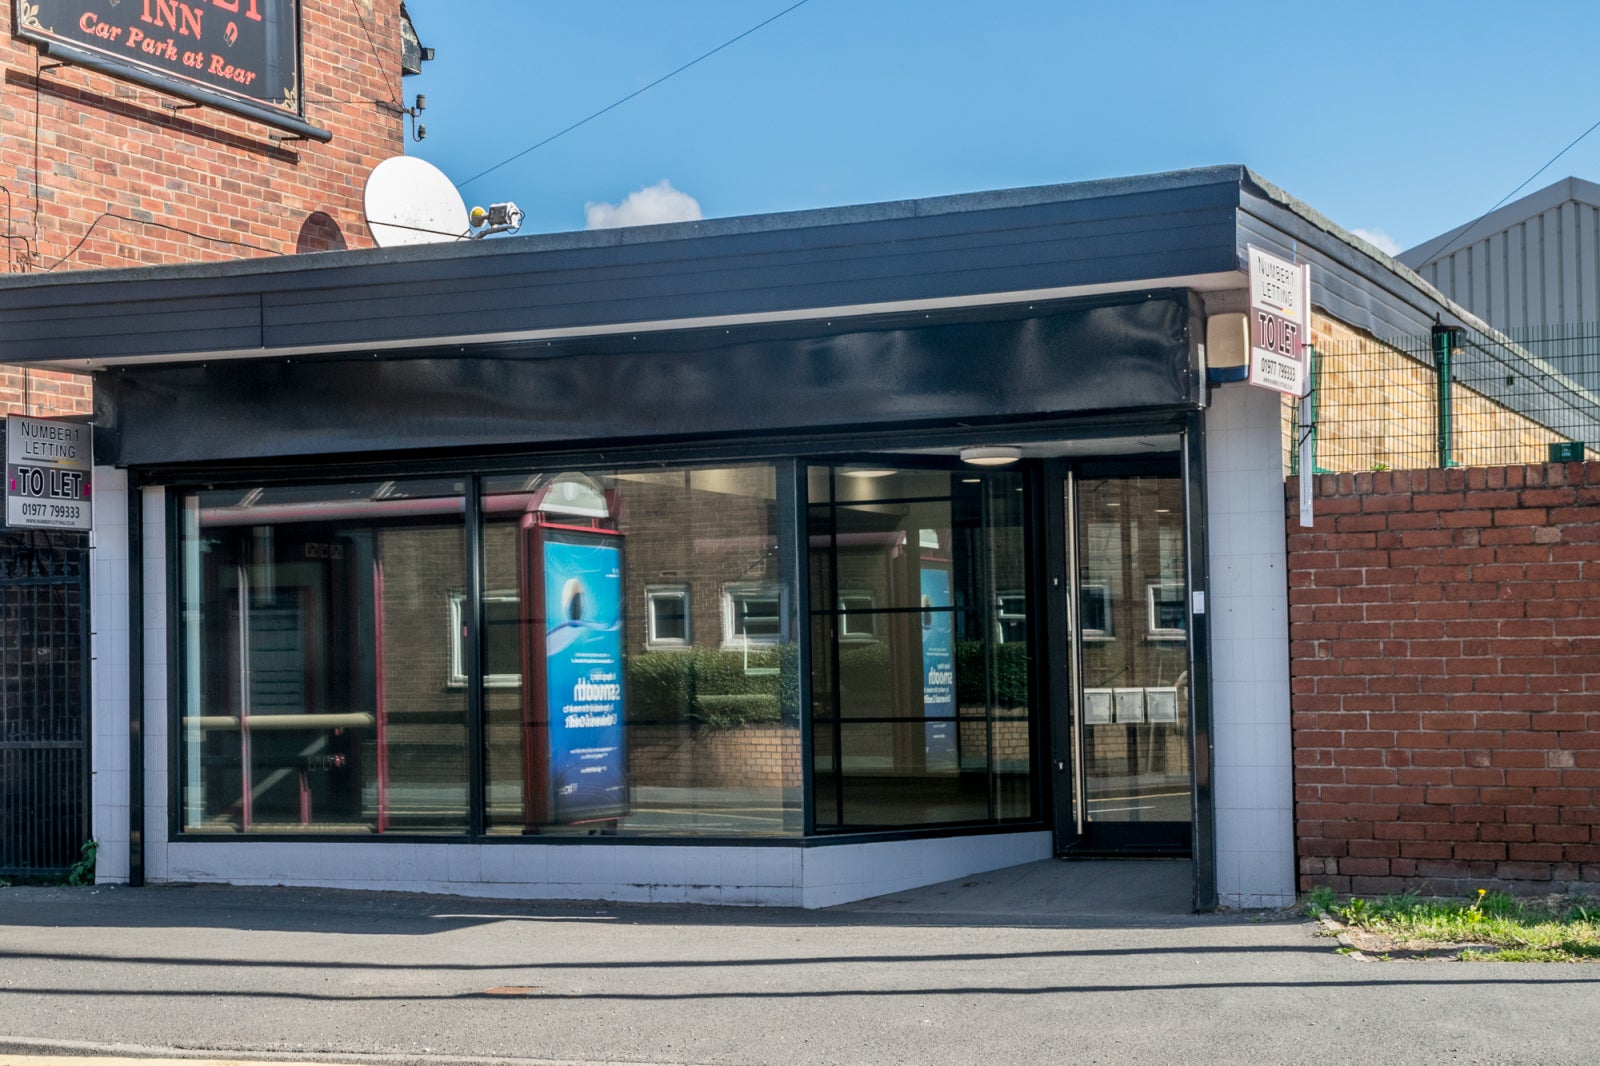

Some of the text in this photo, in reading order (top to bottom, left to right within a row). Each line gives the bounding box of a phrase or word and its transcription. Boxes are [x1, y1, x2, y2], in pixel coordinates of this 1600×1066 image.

[140, 0, 204, 40] INN
[79, 12, 257, 86] Car Park at Rear
[1257, 255, 1290, 286] NUMBER
[1262, 280, 1293, 307] LETTING
[1258, 311, 1297, 358] TO LET
[21, 421, 72, 441] NUMBER
[25, 441, 76, 459] LETTING
[18, 467, 82, 500] TO LET
[22, 503, 80, 519] 01977 799333
